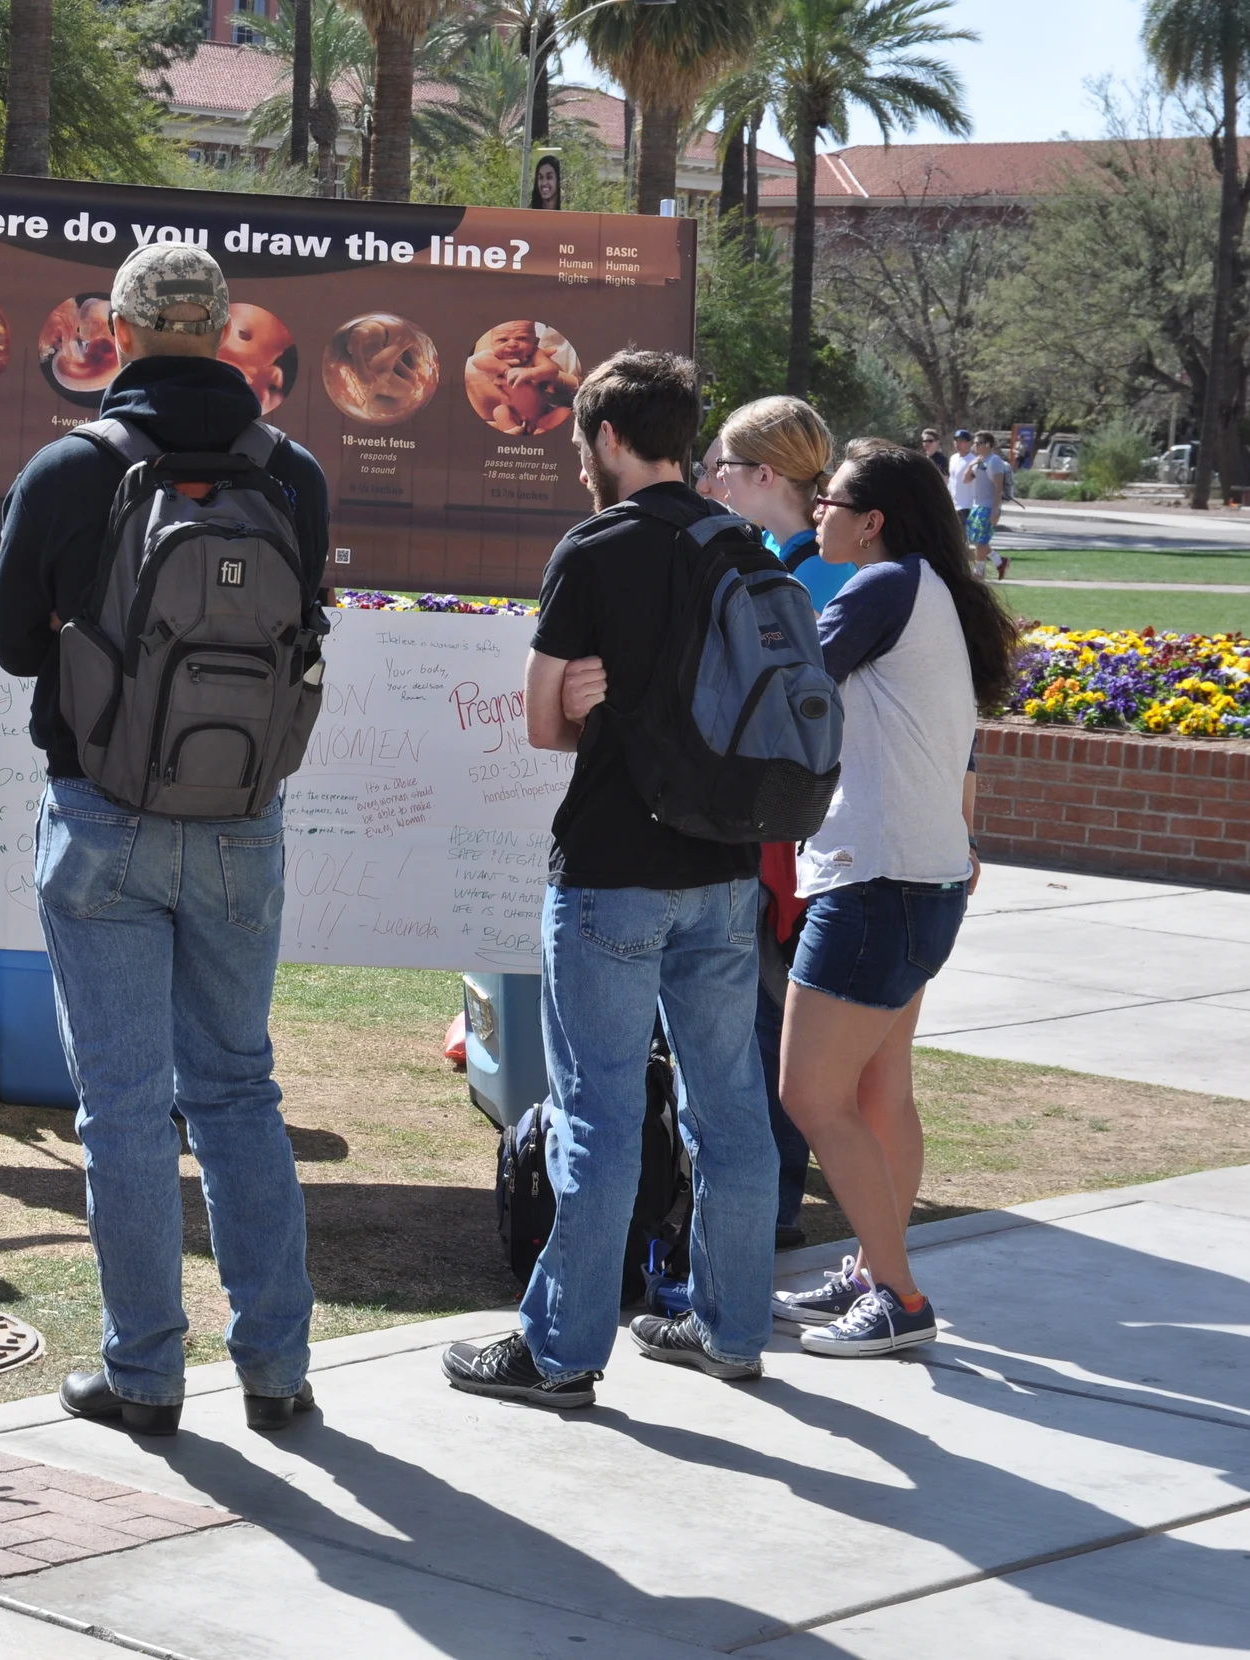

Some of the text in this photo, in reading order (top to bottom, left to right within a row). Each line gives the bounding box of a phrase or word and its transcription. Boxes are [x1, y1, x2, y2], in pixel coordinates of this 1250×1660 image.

[63, 211, 117, 243] do
[223, 223, 331, 258] draw
[345, 230, 415, 263] the
[430, 235, 530, 270] line?
[559, 244, 575, 255] NO
[606, 246, 638, 258] BASIC
[559, 258, 593, 270] Human
[606, 260, 640, 272] Human
[558, 272, 589, 285] Rights
[605, 274, 636, 287] Rights
[341, 434, 416, 449] 18-week fetus
[497, 445, 545, 456] newborn
[359, 452, 398, 462] responds
[360, 464, 396, 475] to sound
[484, 459, 558, 471] passes mirror test
[498, 471, 517, 480] mos.
[518, 472, 539, 481] after
[539, 473, 559, 483] birth
[385, 657, 450, 680] Your body,
[411, 681, 445, 691] decision
[290, 790, 303, 800] of
[334, 807, 349, 815] ALL
[361, 813, 374, 825] be
[377, 806, 396, 819] able
[398, 806, 408, 815] to
[448, 824, 519, 847] ABORTION
[447, 847, 544, 868] SAFE LEGAL
[463, 870, 504, 881] WANT
[508, 874, 520, 884] TO
[500, 891, 517, 903] AN
[481, 905, 495, 916] IS
[461, 922, 473, 935] A
